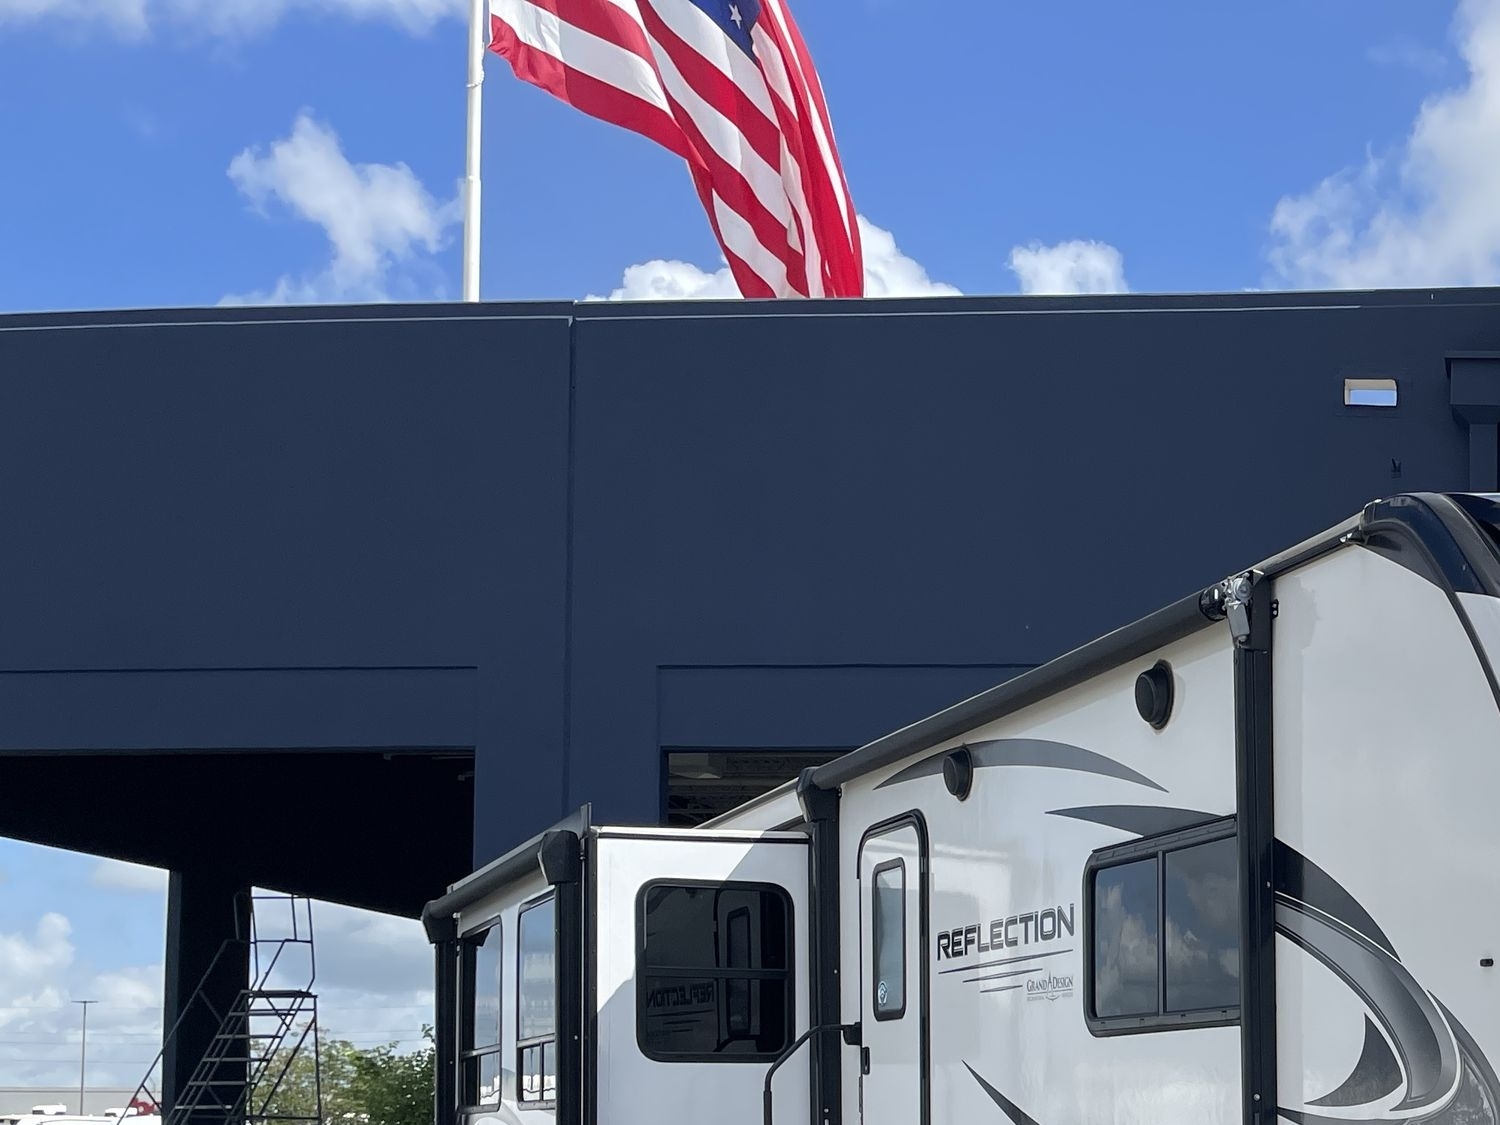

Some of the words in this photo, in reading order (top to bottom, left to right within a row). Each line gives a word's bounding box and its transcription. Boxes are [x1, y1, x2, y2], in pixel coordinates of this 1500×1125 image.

[937, 903, 1075, 961] REFLECTION
[1027, 979, 1048, 992] GRAND
[1052, 975, 1074, 990] DESIGN
